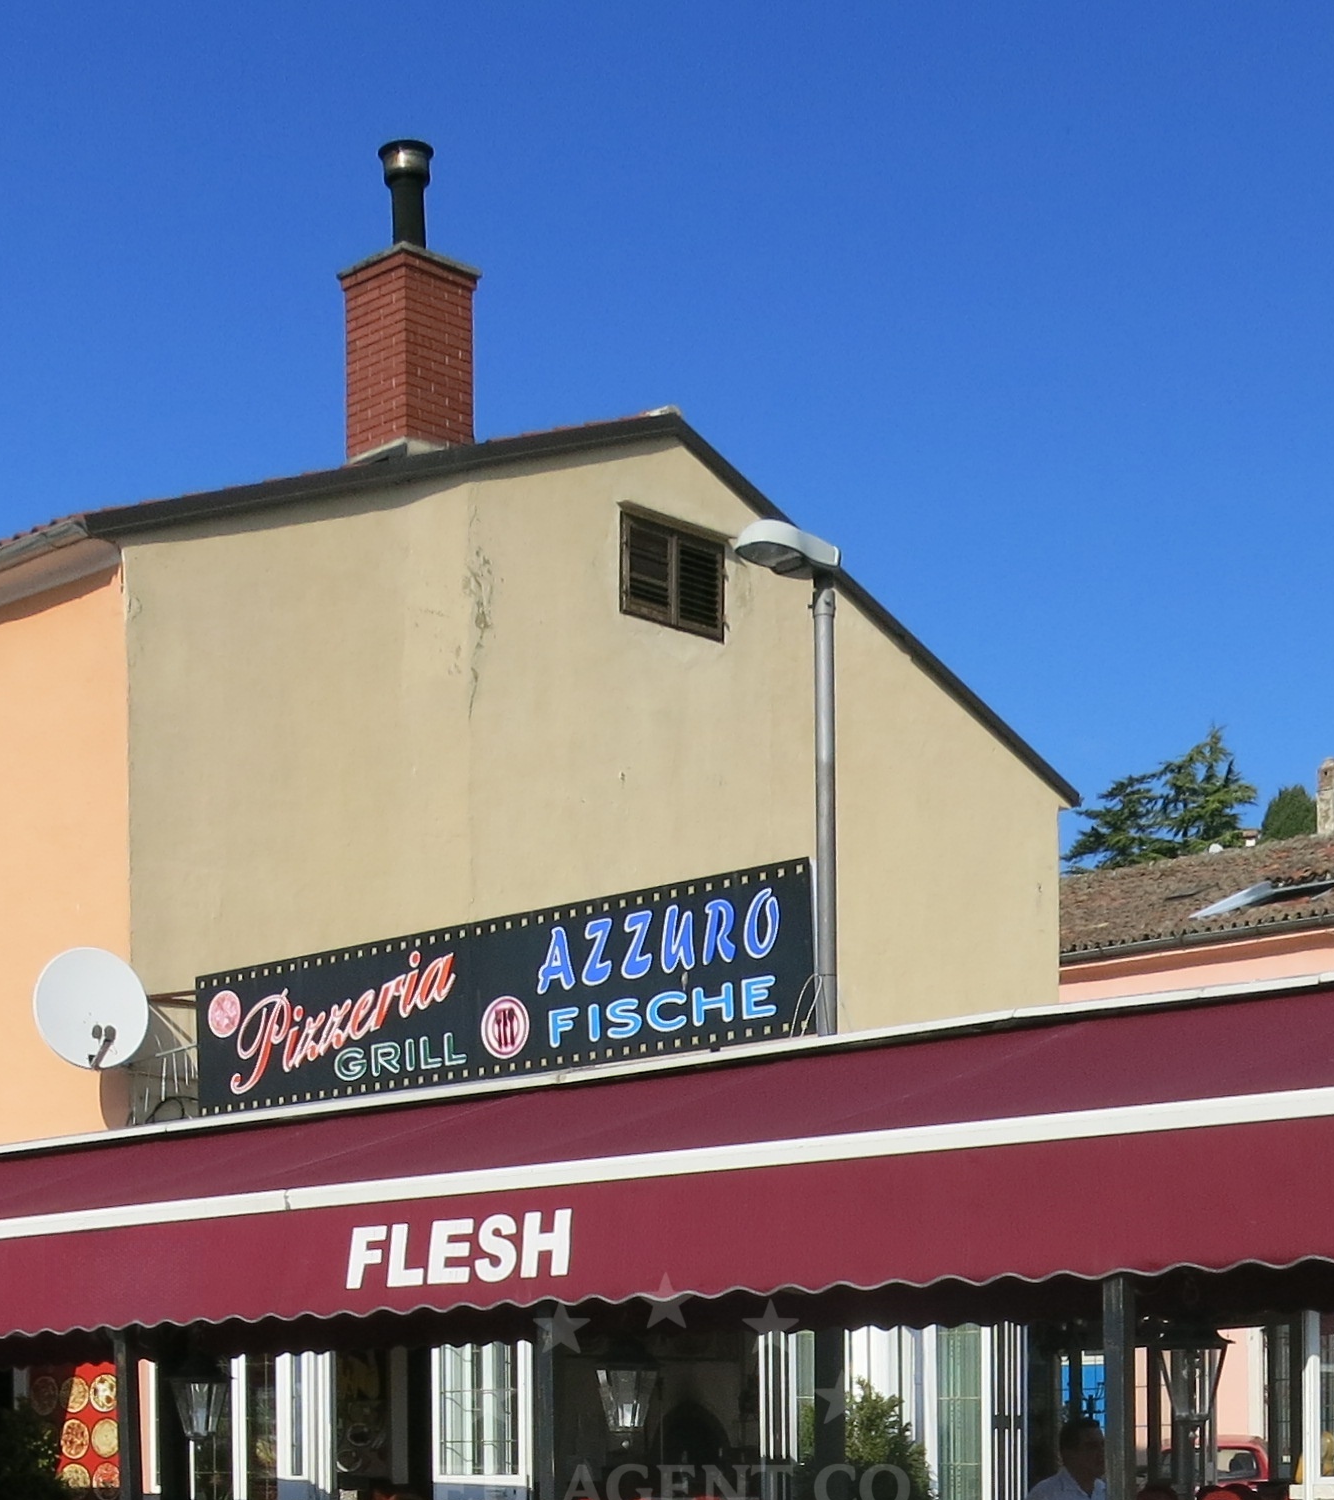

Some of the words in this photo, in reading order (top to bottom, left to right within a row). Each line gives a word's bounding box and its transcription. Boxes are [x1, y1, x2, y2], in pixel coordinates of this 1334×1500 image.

[537, 887, 779, 994] AZZURO
[230, 951, 457, 1095] Pizzeria
[548, 975, 777, 1048] FISCHE
[334, 1032, 467, 1081] GRILL
[345, 1208, 572, 1290] FLESH
